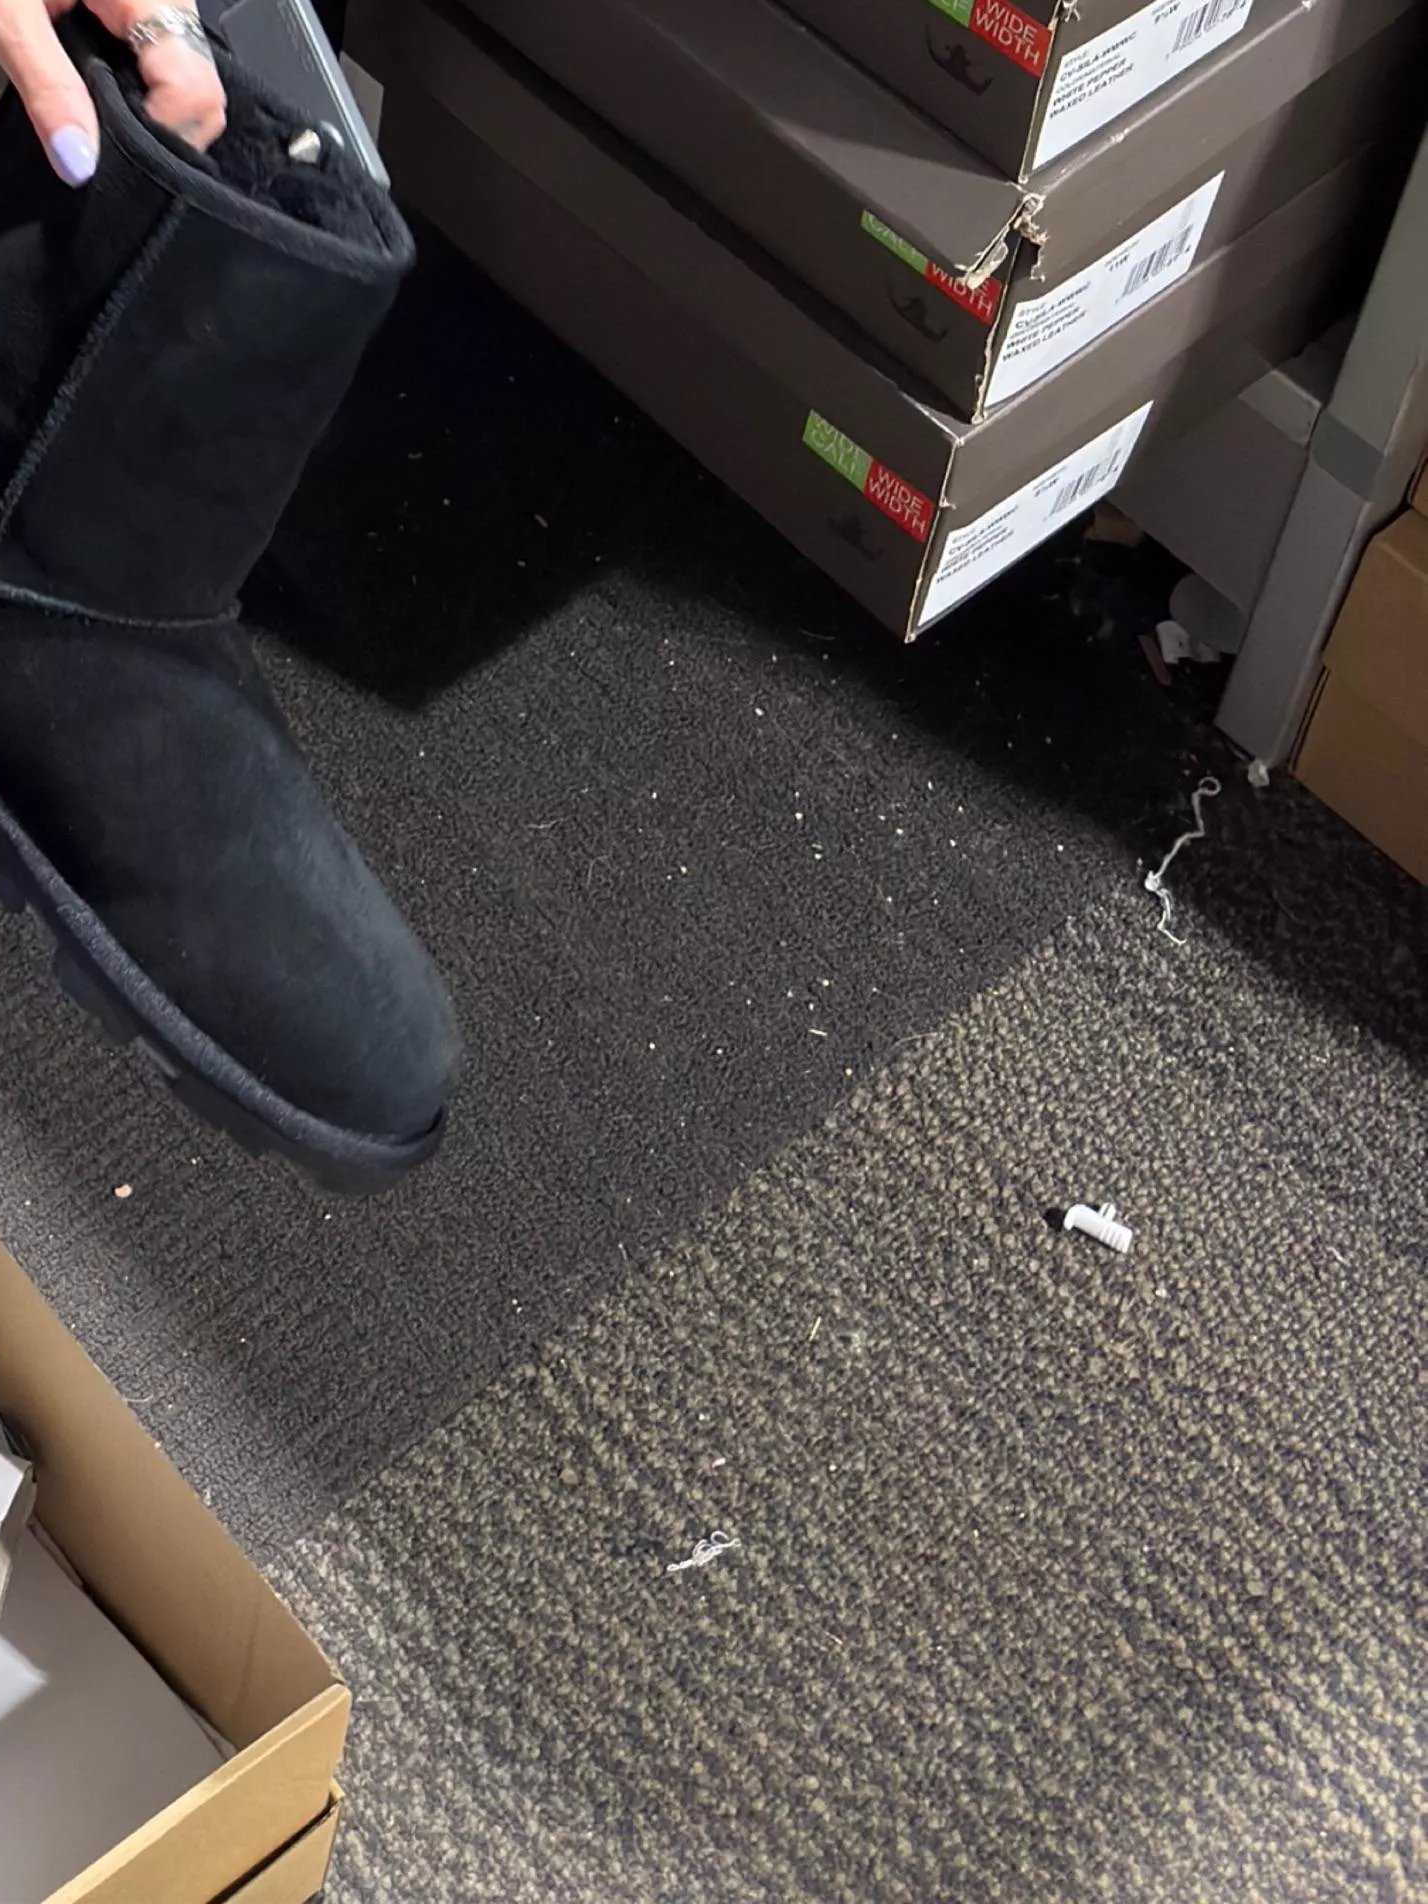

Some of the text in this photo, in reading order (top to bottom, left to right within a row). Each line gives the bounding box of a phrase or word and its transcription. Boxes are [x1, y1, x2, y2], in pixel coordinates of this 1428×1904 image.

[974, 7, 1041, 67] WIDTH
[868, 477, 928, 534] WIDTH
[876, 465, 926, 511] WIDE
